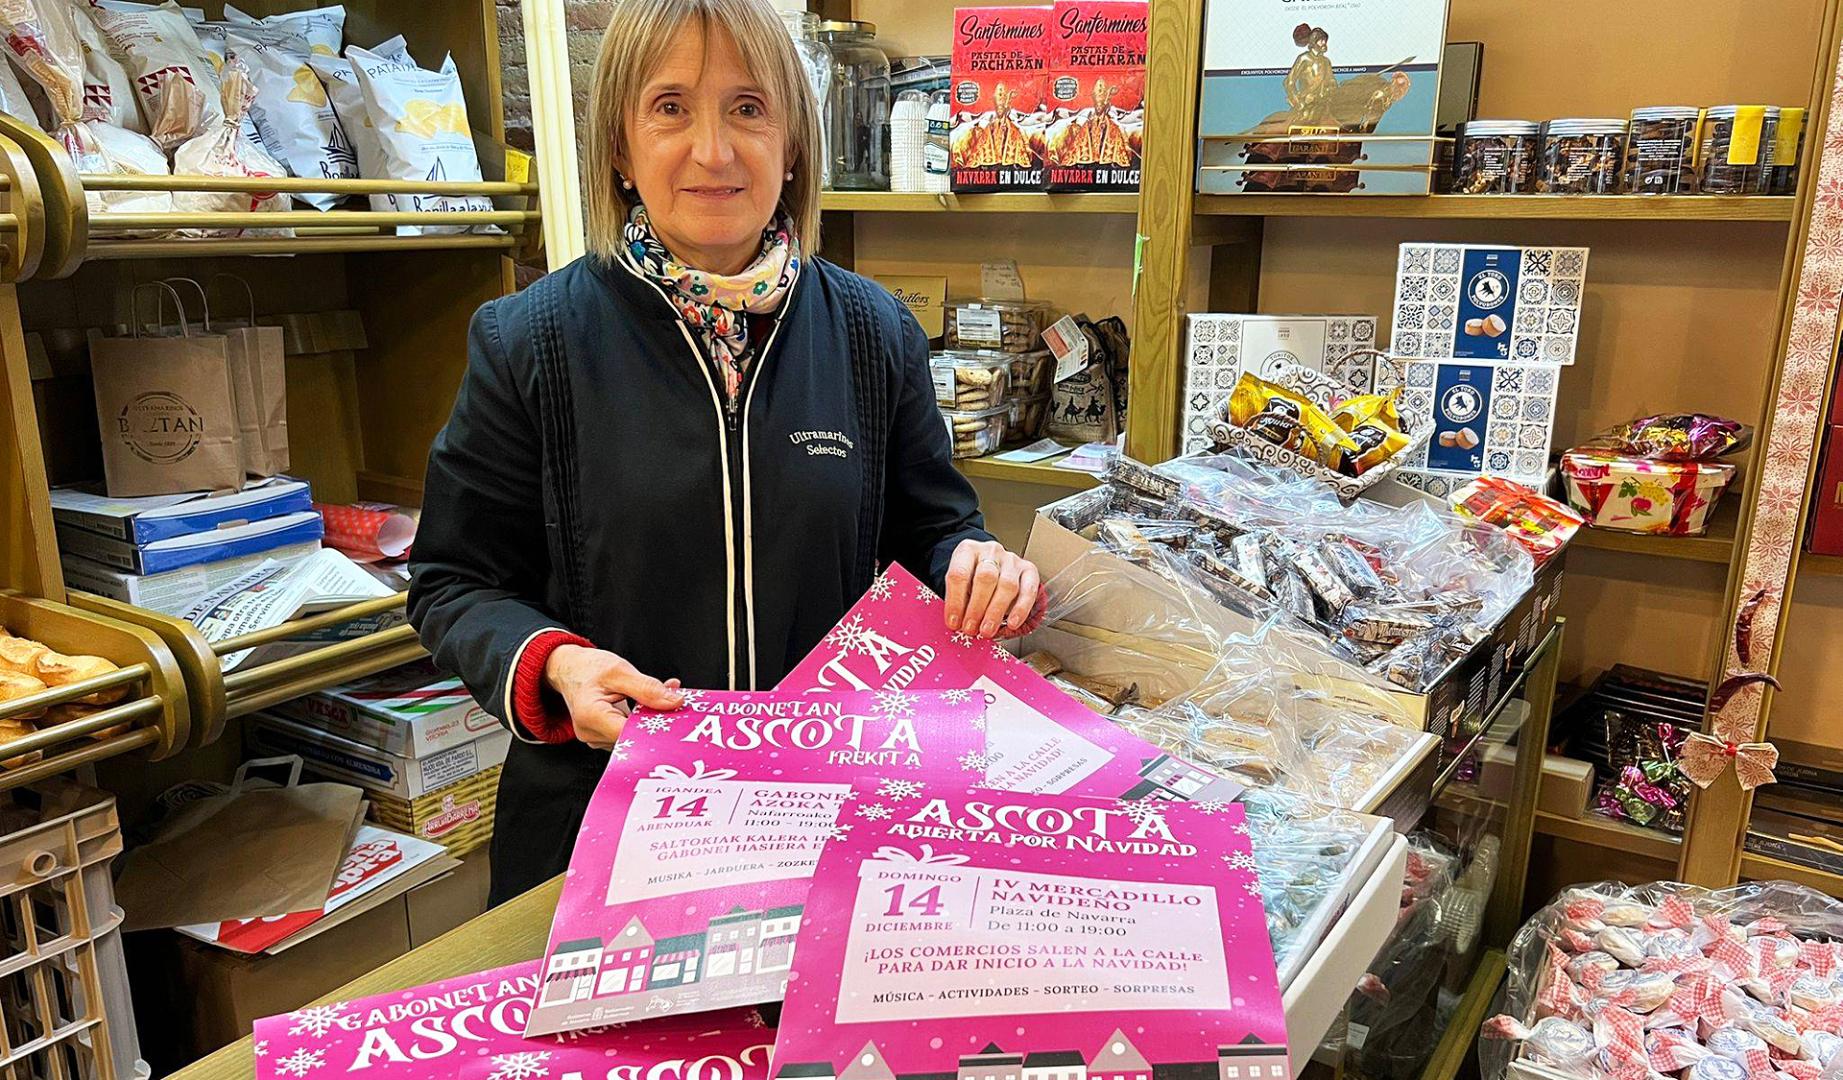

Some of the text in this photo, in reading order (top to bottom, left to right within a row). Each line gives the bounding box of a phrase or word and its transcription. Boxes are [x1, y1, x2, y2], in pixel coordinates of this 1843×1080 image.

[959, 15, 1045, 47] Sanfermines
[1059, 7, 1147, 40] Sanfermines
[971, 51, 1024, 60] PASTAS DE
[1070, 45, 1125, 55] PASTAS DE
[1070, 51, 1146, 66] PACHARÁN
[970, 55, 1044, 71] PACHARÁN
[955, 168, 1042, 185] NAVARRA EN DULCE
[1050, 166, 1140, 184] NAVARRA EN DULCE
[806, 443, 847, 458] Selectos
[693, 701, 842, 717] GABONETAN
[681, 714, 924, 752] ASCOTA
[826, 750, 922, 767] IREKITA
[655, 786, 723, 794] IGANDEA
[653, 795, 709, 819] 14
[750, 800, 825, 809] AZOKA
[748, 809, 832, 819] Nafarroako
[905, 798, 1181, 843] ASCOTA
[636, 820, 713, 832] ABENDUAK
[650, 835, 740, 851] SALTOKIAK
[746, 834, 808, 842] KALERA
[887, 823, 1198, 857] ABIERTA POR NAVIDAD
[657, 846, 730, 861] GABONEI
[735, 843, 806, 853] HASIERA
[647, 871, 693, 885] MUSIKA
[704, 863, 764, 876] JARDUERA
[777, 860, 817, 868] ZOZKE
[877, 871, 962, 883] DOMINGO
[882, 883, 945, 917] 14
[991, 890, 1132, 912] NAVIDEÑO
[993, 878, 1202, 907] IV MERCADILLO
[988, 905, 1137, 926] Plaza de Navarra
[865, 921, 954, 934] DICIEMBRE
[987, 920, 1127, 937] De 11:00 a 19:00
[864, 944, 1204, 964] ¡LOS COMERCIOS SALEN A LA CALLE
[877, 957, 1188, 975] PARA DAR INICIO A LA NAVIDAD!
[872, 988, 925, 1003] MÚSICA
[938, 986, 1030, 1000] ACTIVIDADES
[1043, 984, 1099, 995] SORTEO
[1113, 983, 1196, 995] SORPRESAS
[337, 974, 540, 1031] GABONETAN
